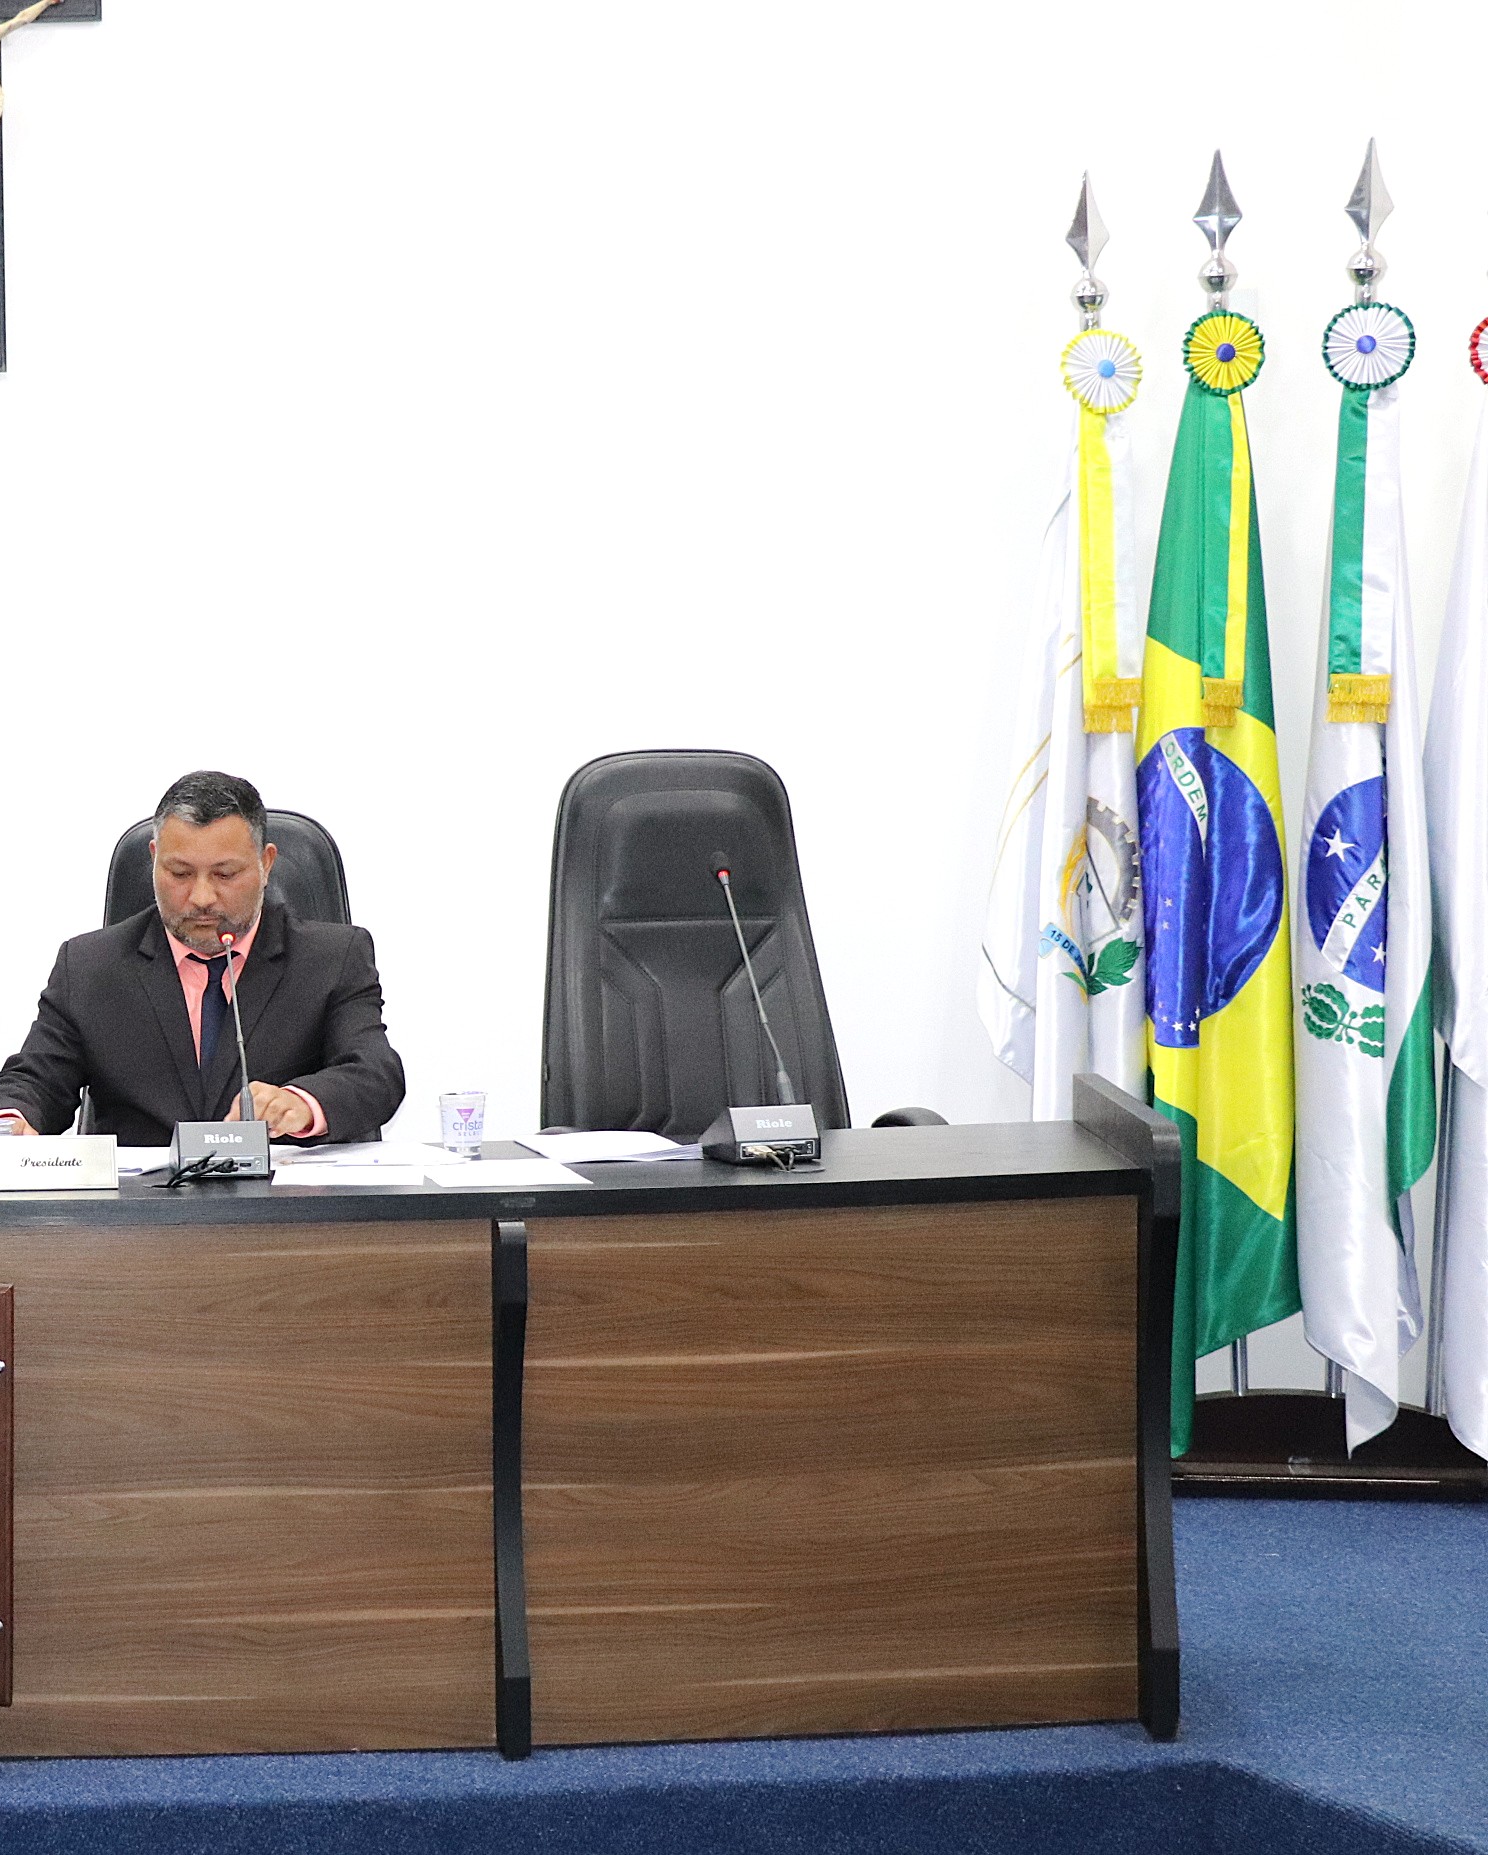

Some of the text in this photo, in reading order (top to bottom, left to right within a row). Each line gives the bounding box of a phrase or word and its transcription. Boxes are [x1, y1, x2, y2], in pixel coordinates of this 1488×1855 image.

[1164, 741, 1208, 823] ORDEM
[1050, 929, 1075, 954] 15 DE
[452, 1120, 483, 1131] crista
[755, 1118, 793, 1130] Riole
[203, 1133, 243, 1145] Riole
[19, 1156, 84, 1169] Presidente
